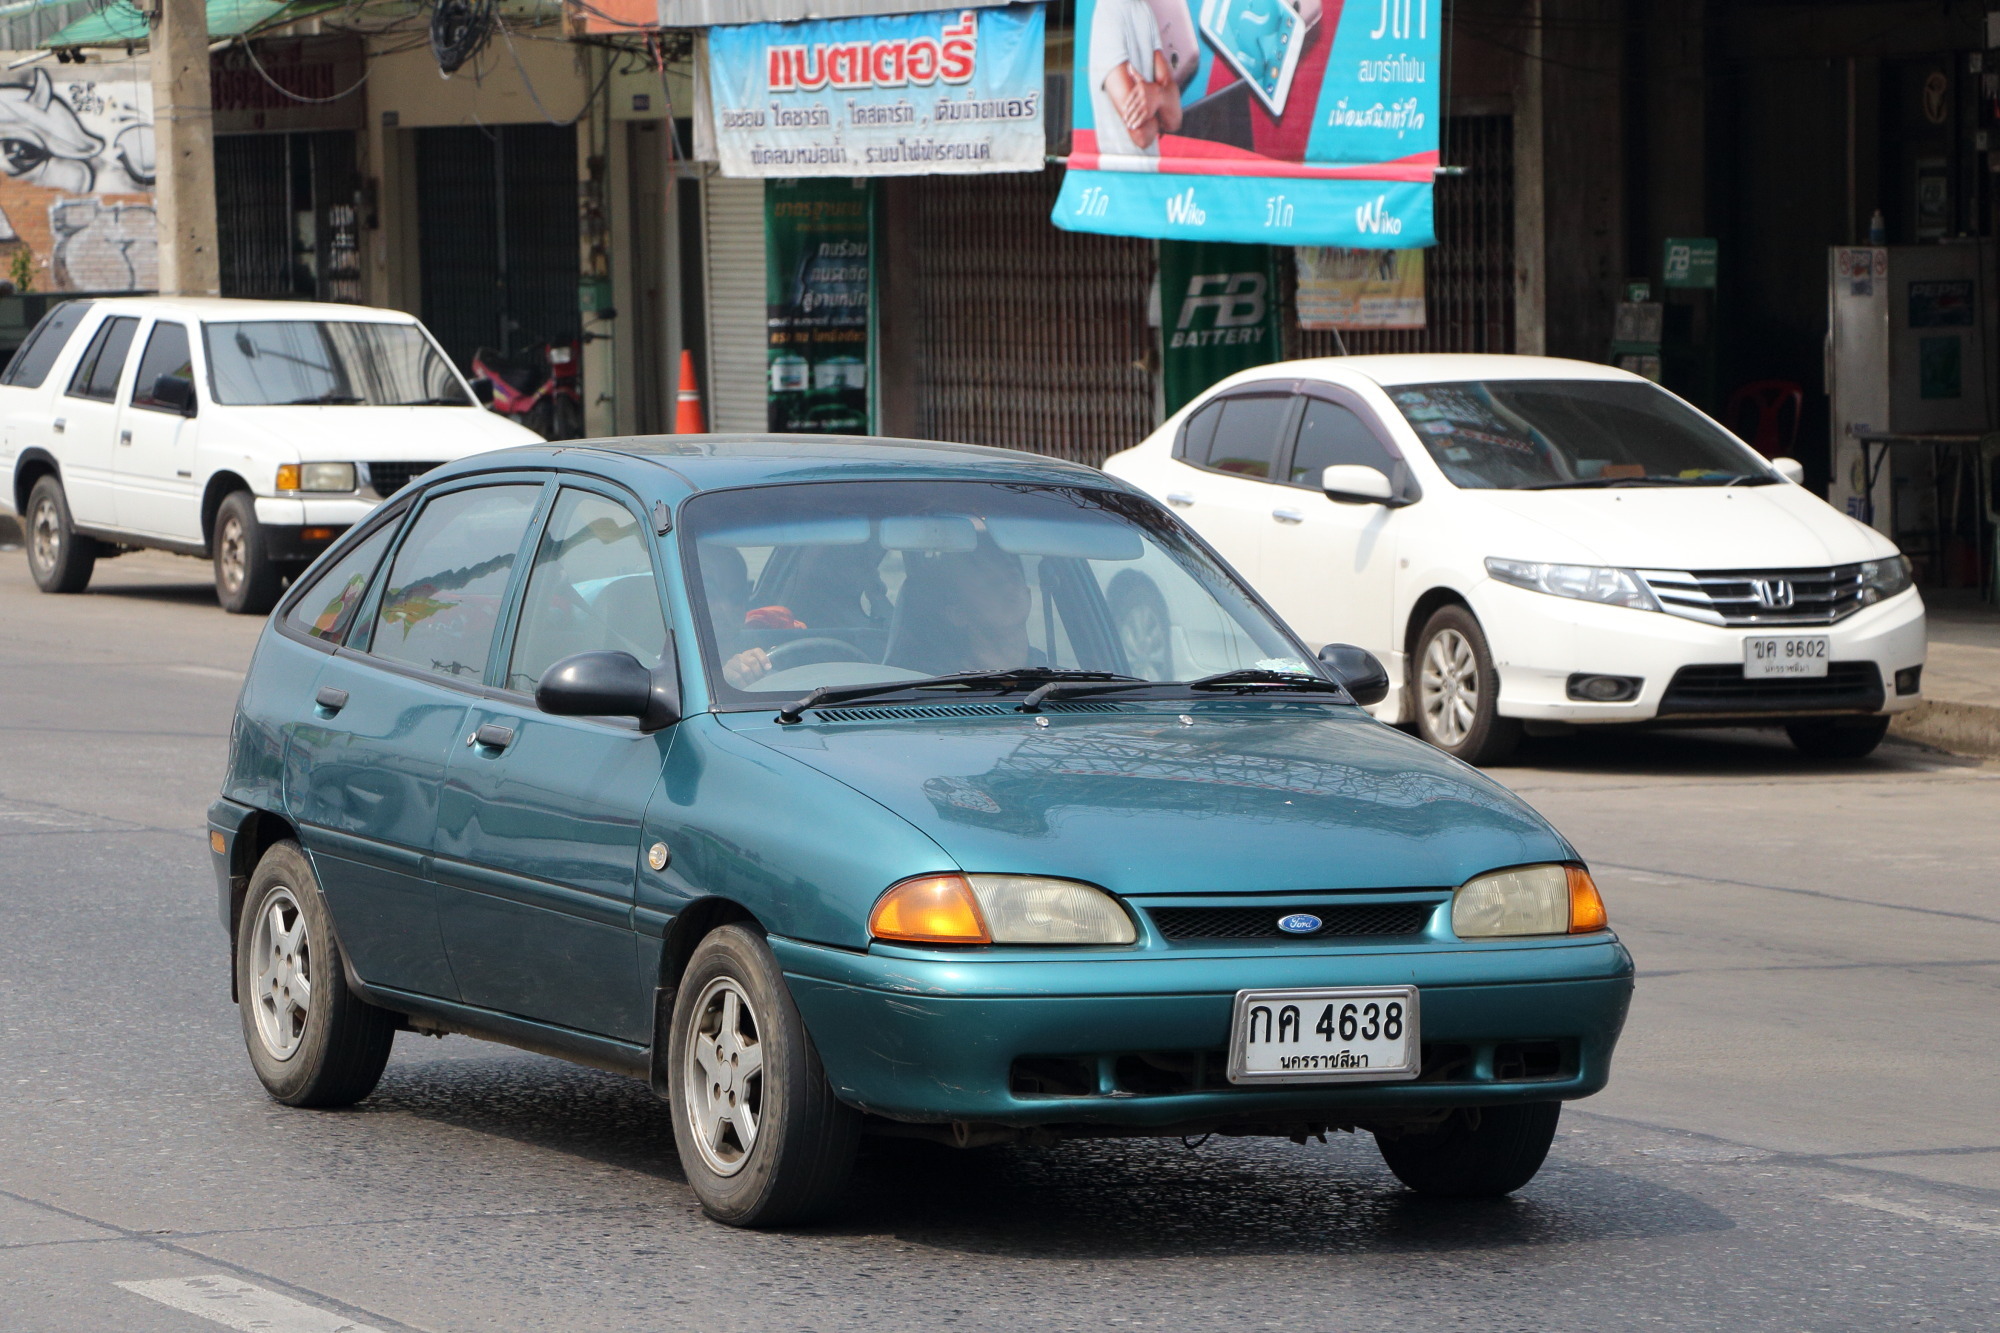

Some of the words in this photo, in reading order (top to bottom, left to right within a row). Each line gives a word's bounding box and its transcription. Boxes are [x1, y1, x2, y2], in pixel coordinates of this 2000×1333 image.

[768, 11, 977, 89] แบตเตอรี่
[1359, 53, 1425, 83] สมาร์ทโฟน
[1076, 187, 1109, 216] วีโก
[1166, 187, 1205, 225] Wiko
[1265, 196, 1293, 228] วีโก
[1355, 195, 1401, 235] Wiko
[1665, 245, 1690, 271] FB
[1177, 272, 1267, 328] FB
[1170, 327, 1266, 349] BATTERY
[1786, 640, 1825, 658] 9602
[1290, 916, 1312, 928] Ford
[1249, 1004, 1301, 1043] กค
[1315, 1002, 1403, 1042] 4638
[1280, 1050, 1369, 1069] นครราชสีมา
